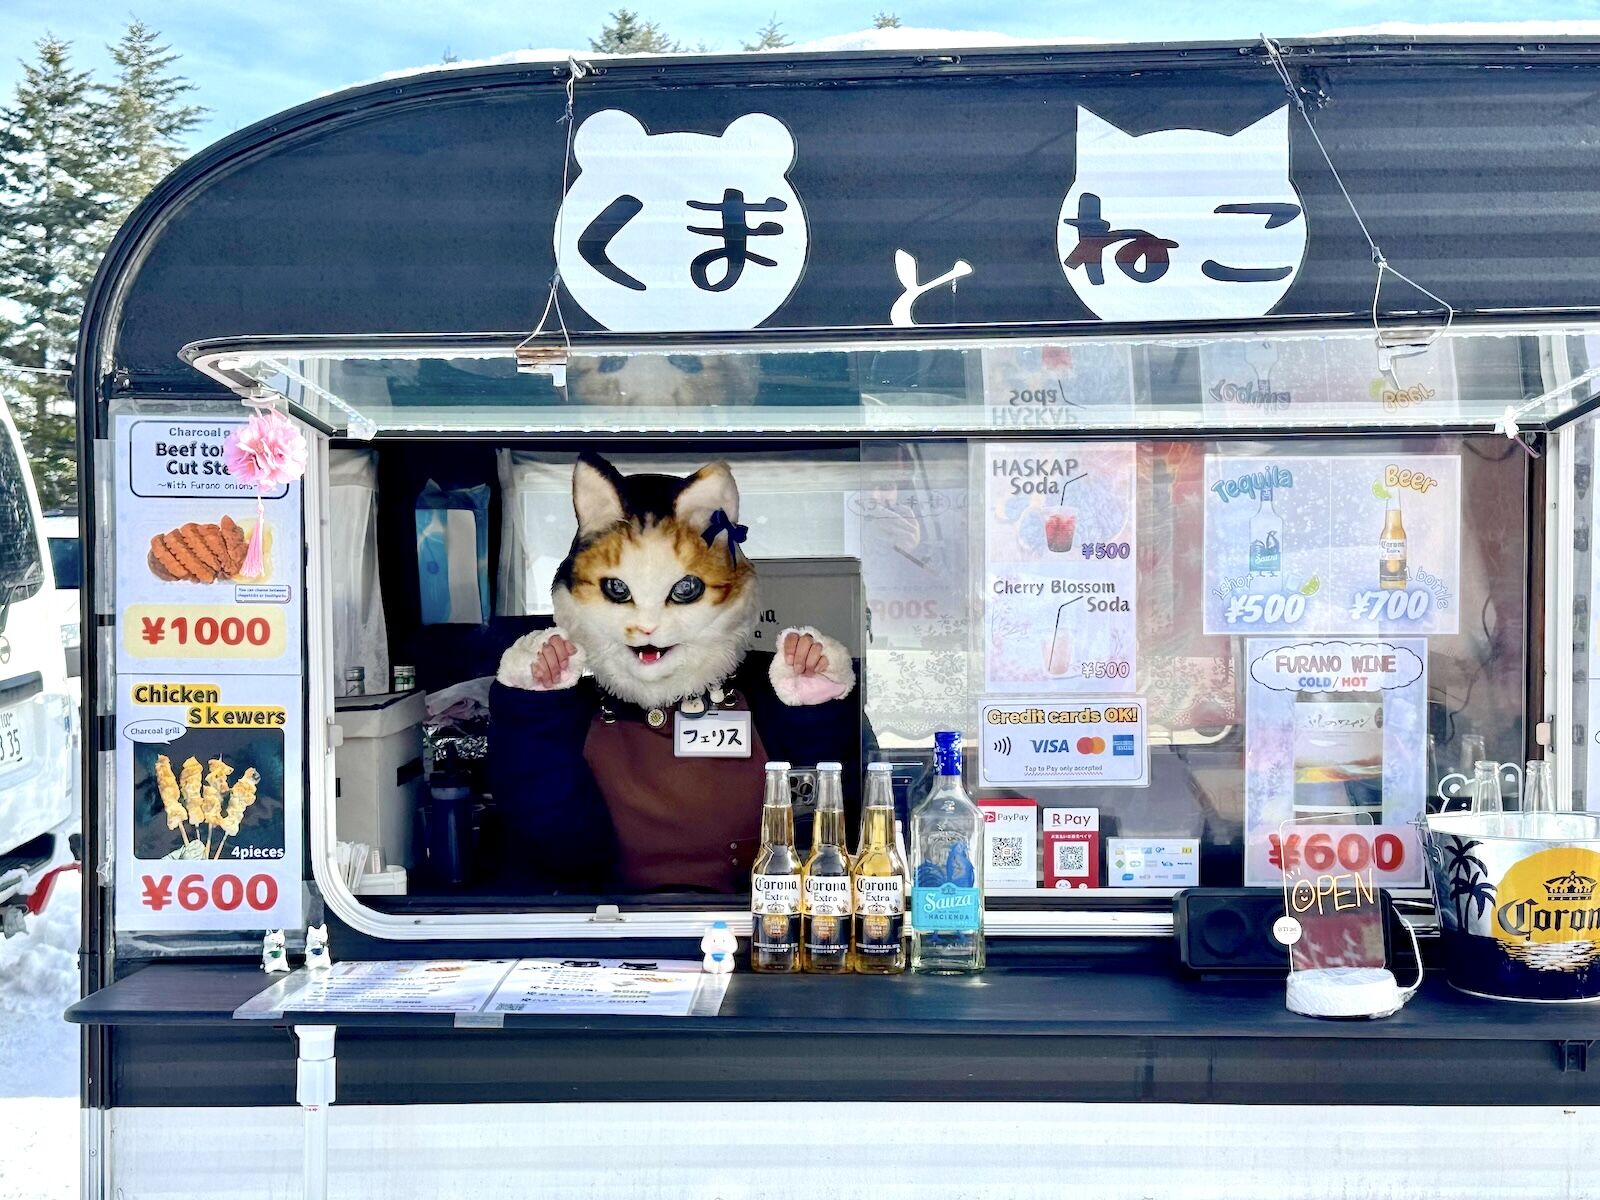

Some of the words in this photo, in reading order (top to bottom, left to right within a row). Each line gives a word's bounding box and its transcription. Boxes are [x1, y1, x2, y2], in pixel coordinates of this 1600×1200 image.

[577, 188, 788, 293] くま
[890, 248, 974, 326] と
[1063, 192, 1301, 286] ねこ
[169, 427, 221, 437] Charcoal
[156, 442, 198, 457] Beef
[166, 461, 198, 475] Cut
[992, 458, 1079, 477] HASKAP
[1010, 477, 1060, 495] Soda
[1211, 465, 1294, 503] Tequila
[1384, 464, 1438, 493] Beer
[1081, 542, 1131, 560] ¥500
[993, 580, 1045, 596] Cherry
[1051, 580, 1116, 594] Blossom
[1087, 596, 1130, 613] Soda
[1224, 593, 1306, 624] ¥500
[1348, 590, 1429, 620] ¥700
[141, 616, 271, 646] ¥1000
[1081, 661, 1131, 679] ¥500
[1275, 655, 1342, 673] FURANO
[1351, 655, 1397, 673] WINE
[1341, 676, 1368, 687] HOT
[134, 684, 219, 703] Chicken
[987, 708, 1046, 725] Credit
[1047, 708, 1103, 724] cards
[1104, 707, 1139, 723] OK!
[130, 727, 164, 735] Charcoal
[164, 727, 180, 736] grill
[683, 728, 743, 747] フェリス
[1029, 739, 1070, 754] VISA
[997, 812, 1030, 823] PayPay
[1064, 813, 1091, 827] Pay
[231, 845, 285, 859] 4pieces
[1268, 833, 1406, 872] ¥600
[141, 873, 279, 912] ¥600
[754, 877, 798, 892] Corona
[805, 879, 847, 892] Corona
[856, 877, 899, 892] Corona
[1291, 872, 1375, 915] OPEN
[764, 891, 791, 900] Extra
[813, 892, 838, 901] Extra
[865, 891, 890, 901] Extra
[924, 892, 971, 913] Sauza
[1497, 898, 1600, 941] Coron
